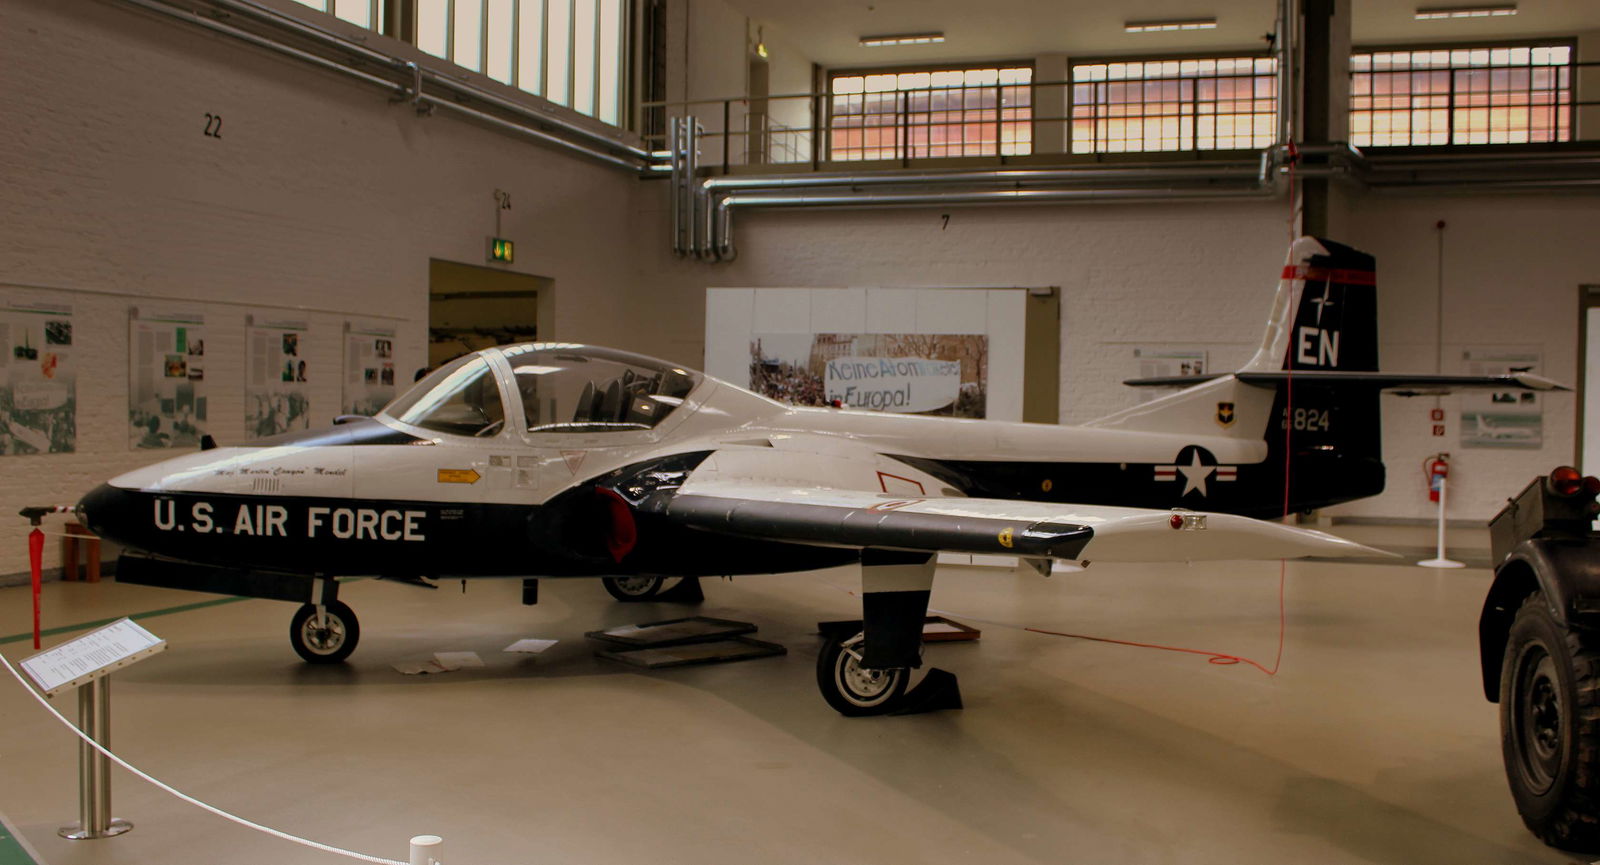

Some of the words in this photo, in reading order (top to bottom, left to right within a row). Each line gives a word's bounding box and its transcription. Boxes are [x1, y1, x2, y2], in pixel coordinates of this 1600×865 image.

[203, 112, 222, 140] 22
[941, 213, 950, 231] 7
[1297, 326, 1340, 367] EN
[829, 361, 878, 381] Keine
[845, 382, 911, 411] Europa!
[1294, 408, 1330, 431] 824
[234, 504, 288, 537] AIR
[308, 507, 427, 541] FORCE
